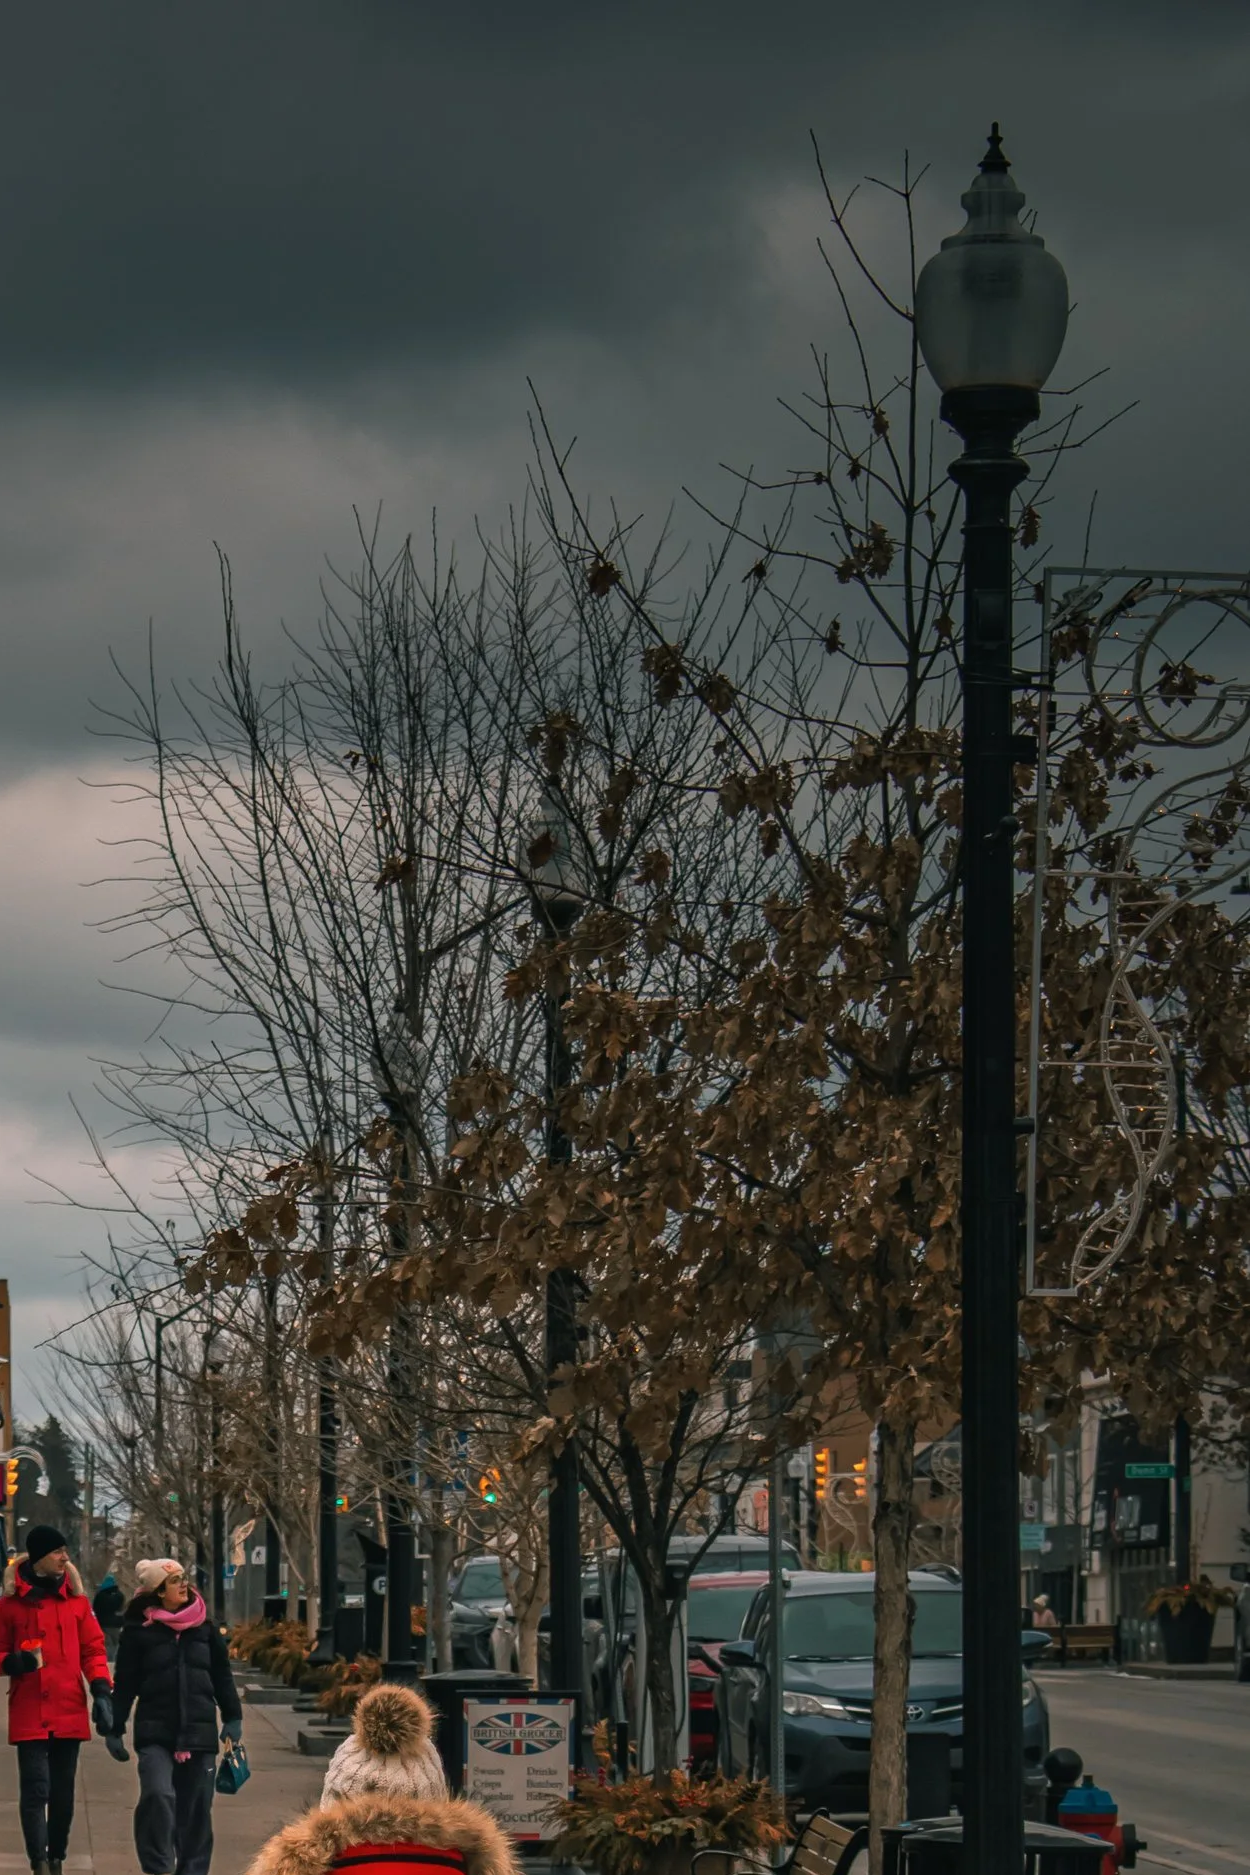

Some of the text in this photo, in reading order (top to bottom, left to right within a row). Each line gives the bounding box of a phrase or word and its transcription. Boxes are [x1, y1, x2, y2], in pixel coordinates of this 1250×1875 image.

[473, 1728, 563, 1738] BRITISH GROCER
[473, 1766, 505, 1776] Sweets
[526, 1766, 558, 1776] Drinks
[473, 1779, 501, 1790] Crisps
[495, 1812, 551, 1824] rocerie
